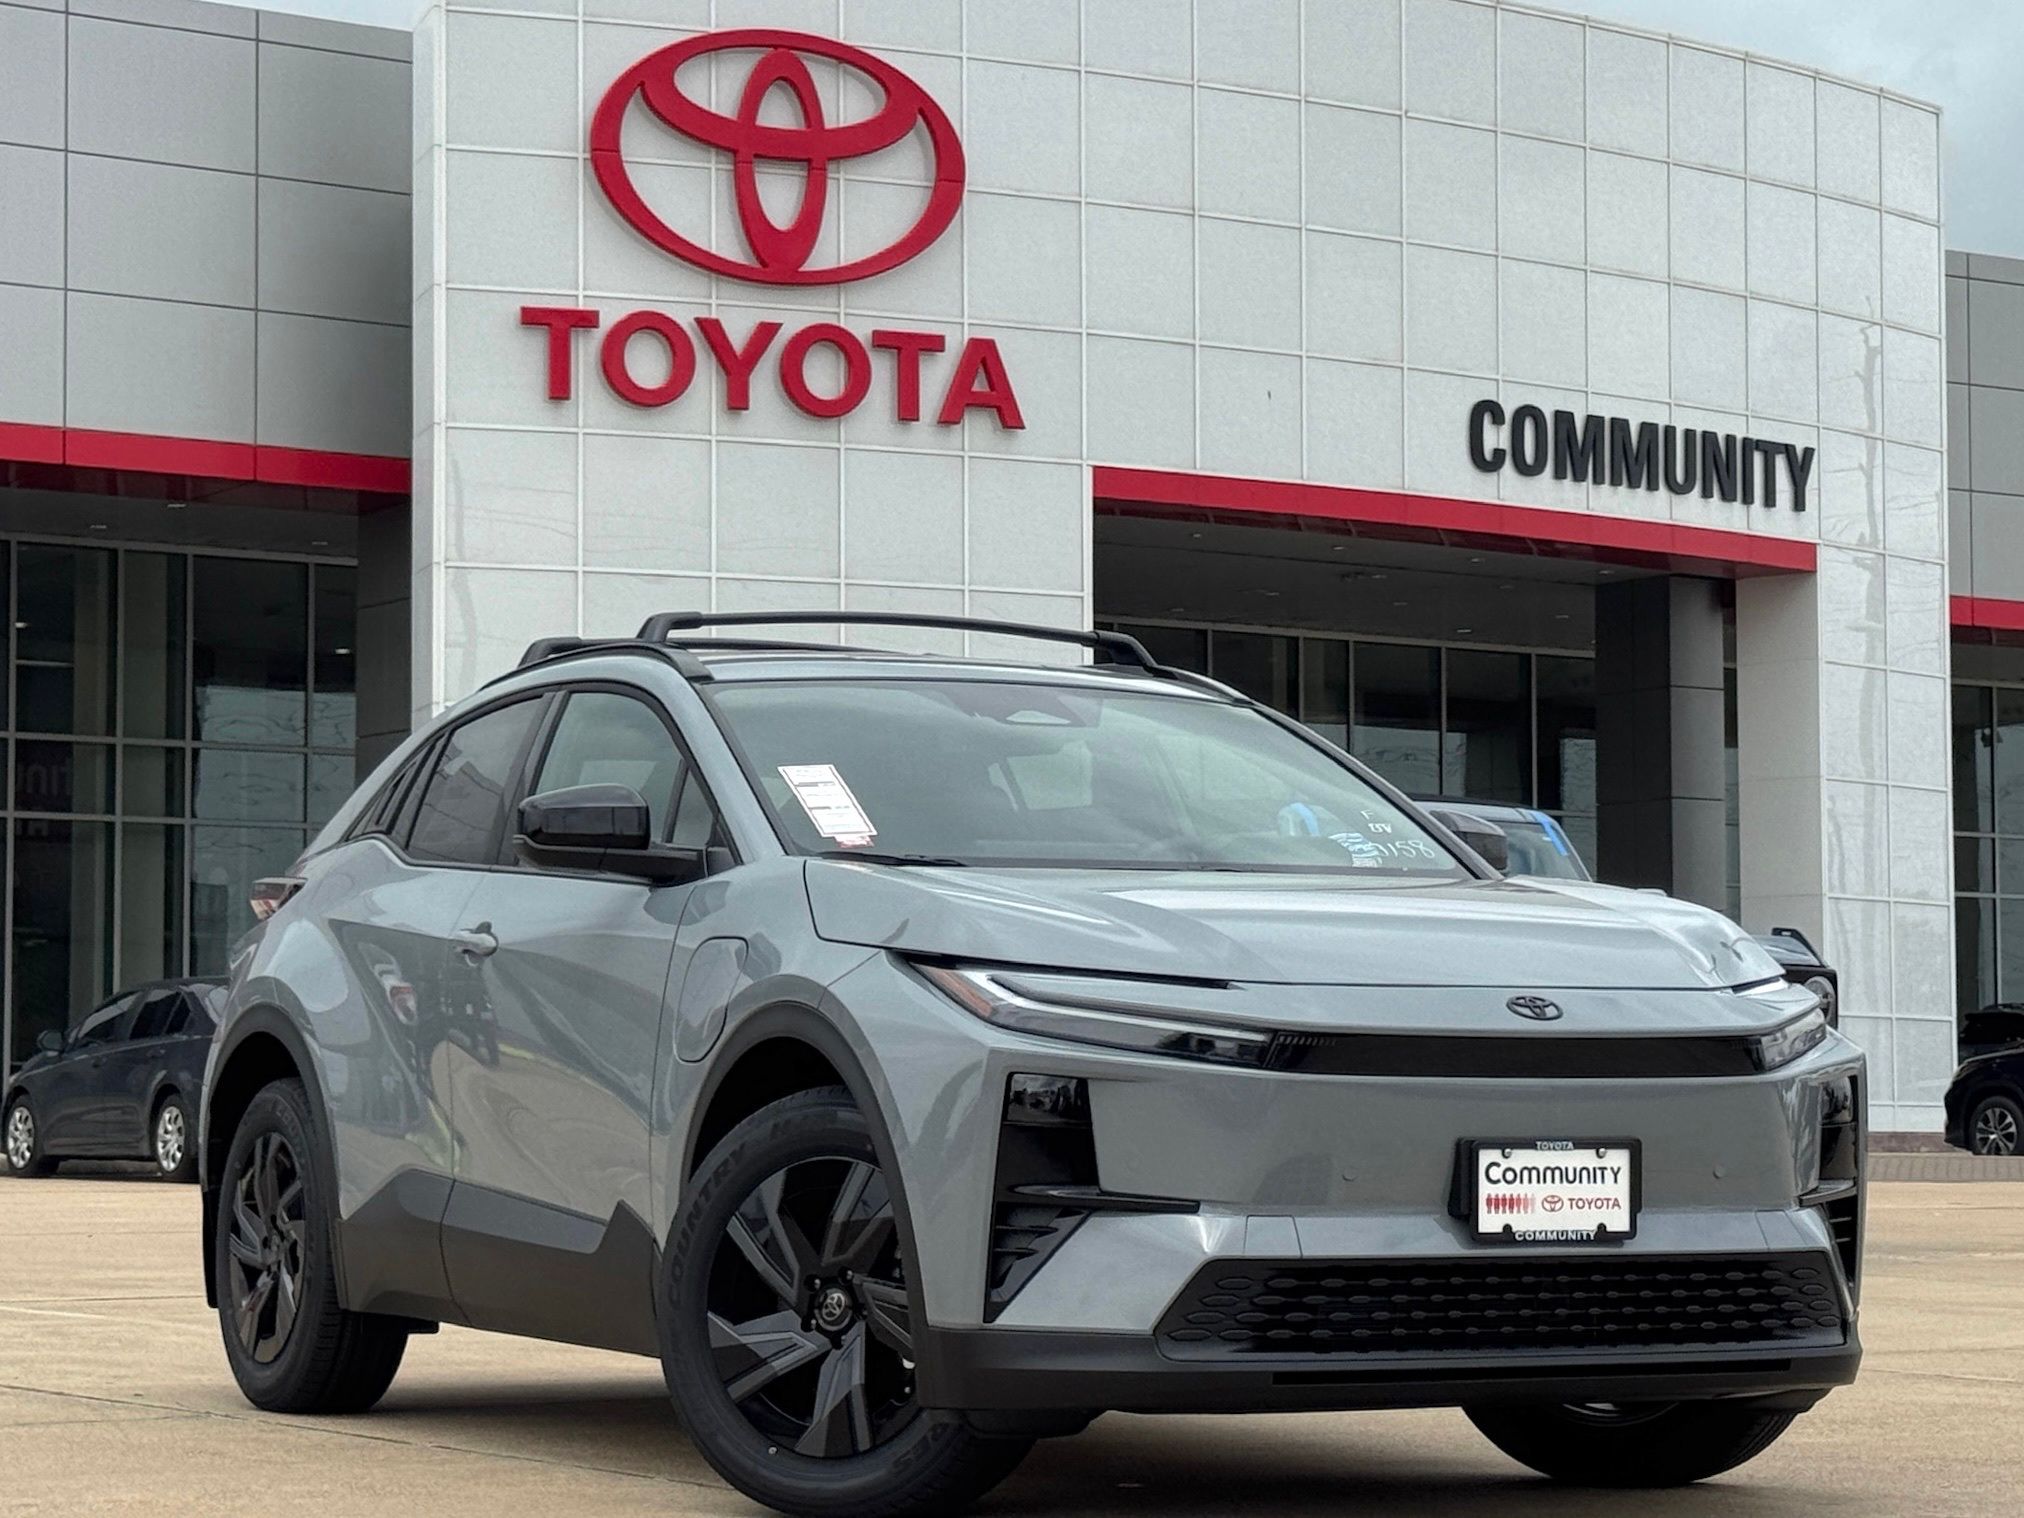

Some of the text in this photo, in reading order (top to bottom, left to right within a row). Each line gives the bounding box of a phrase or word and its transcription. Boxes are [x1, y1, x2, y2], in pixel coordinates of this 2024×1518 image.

[521, 306, 1026, 430] TOYOTA
[1469, 399, 1816, 512] COMMUNITY
[1535, 1141, 1575, 1150] TOYOTA
[1568, 1197, 1622, 1210] TOYOTA
[1514, 1230, 1597, 1241] COMMUNITY
